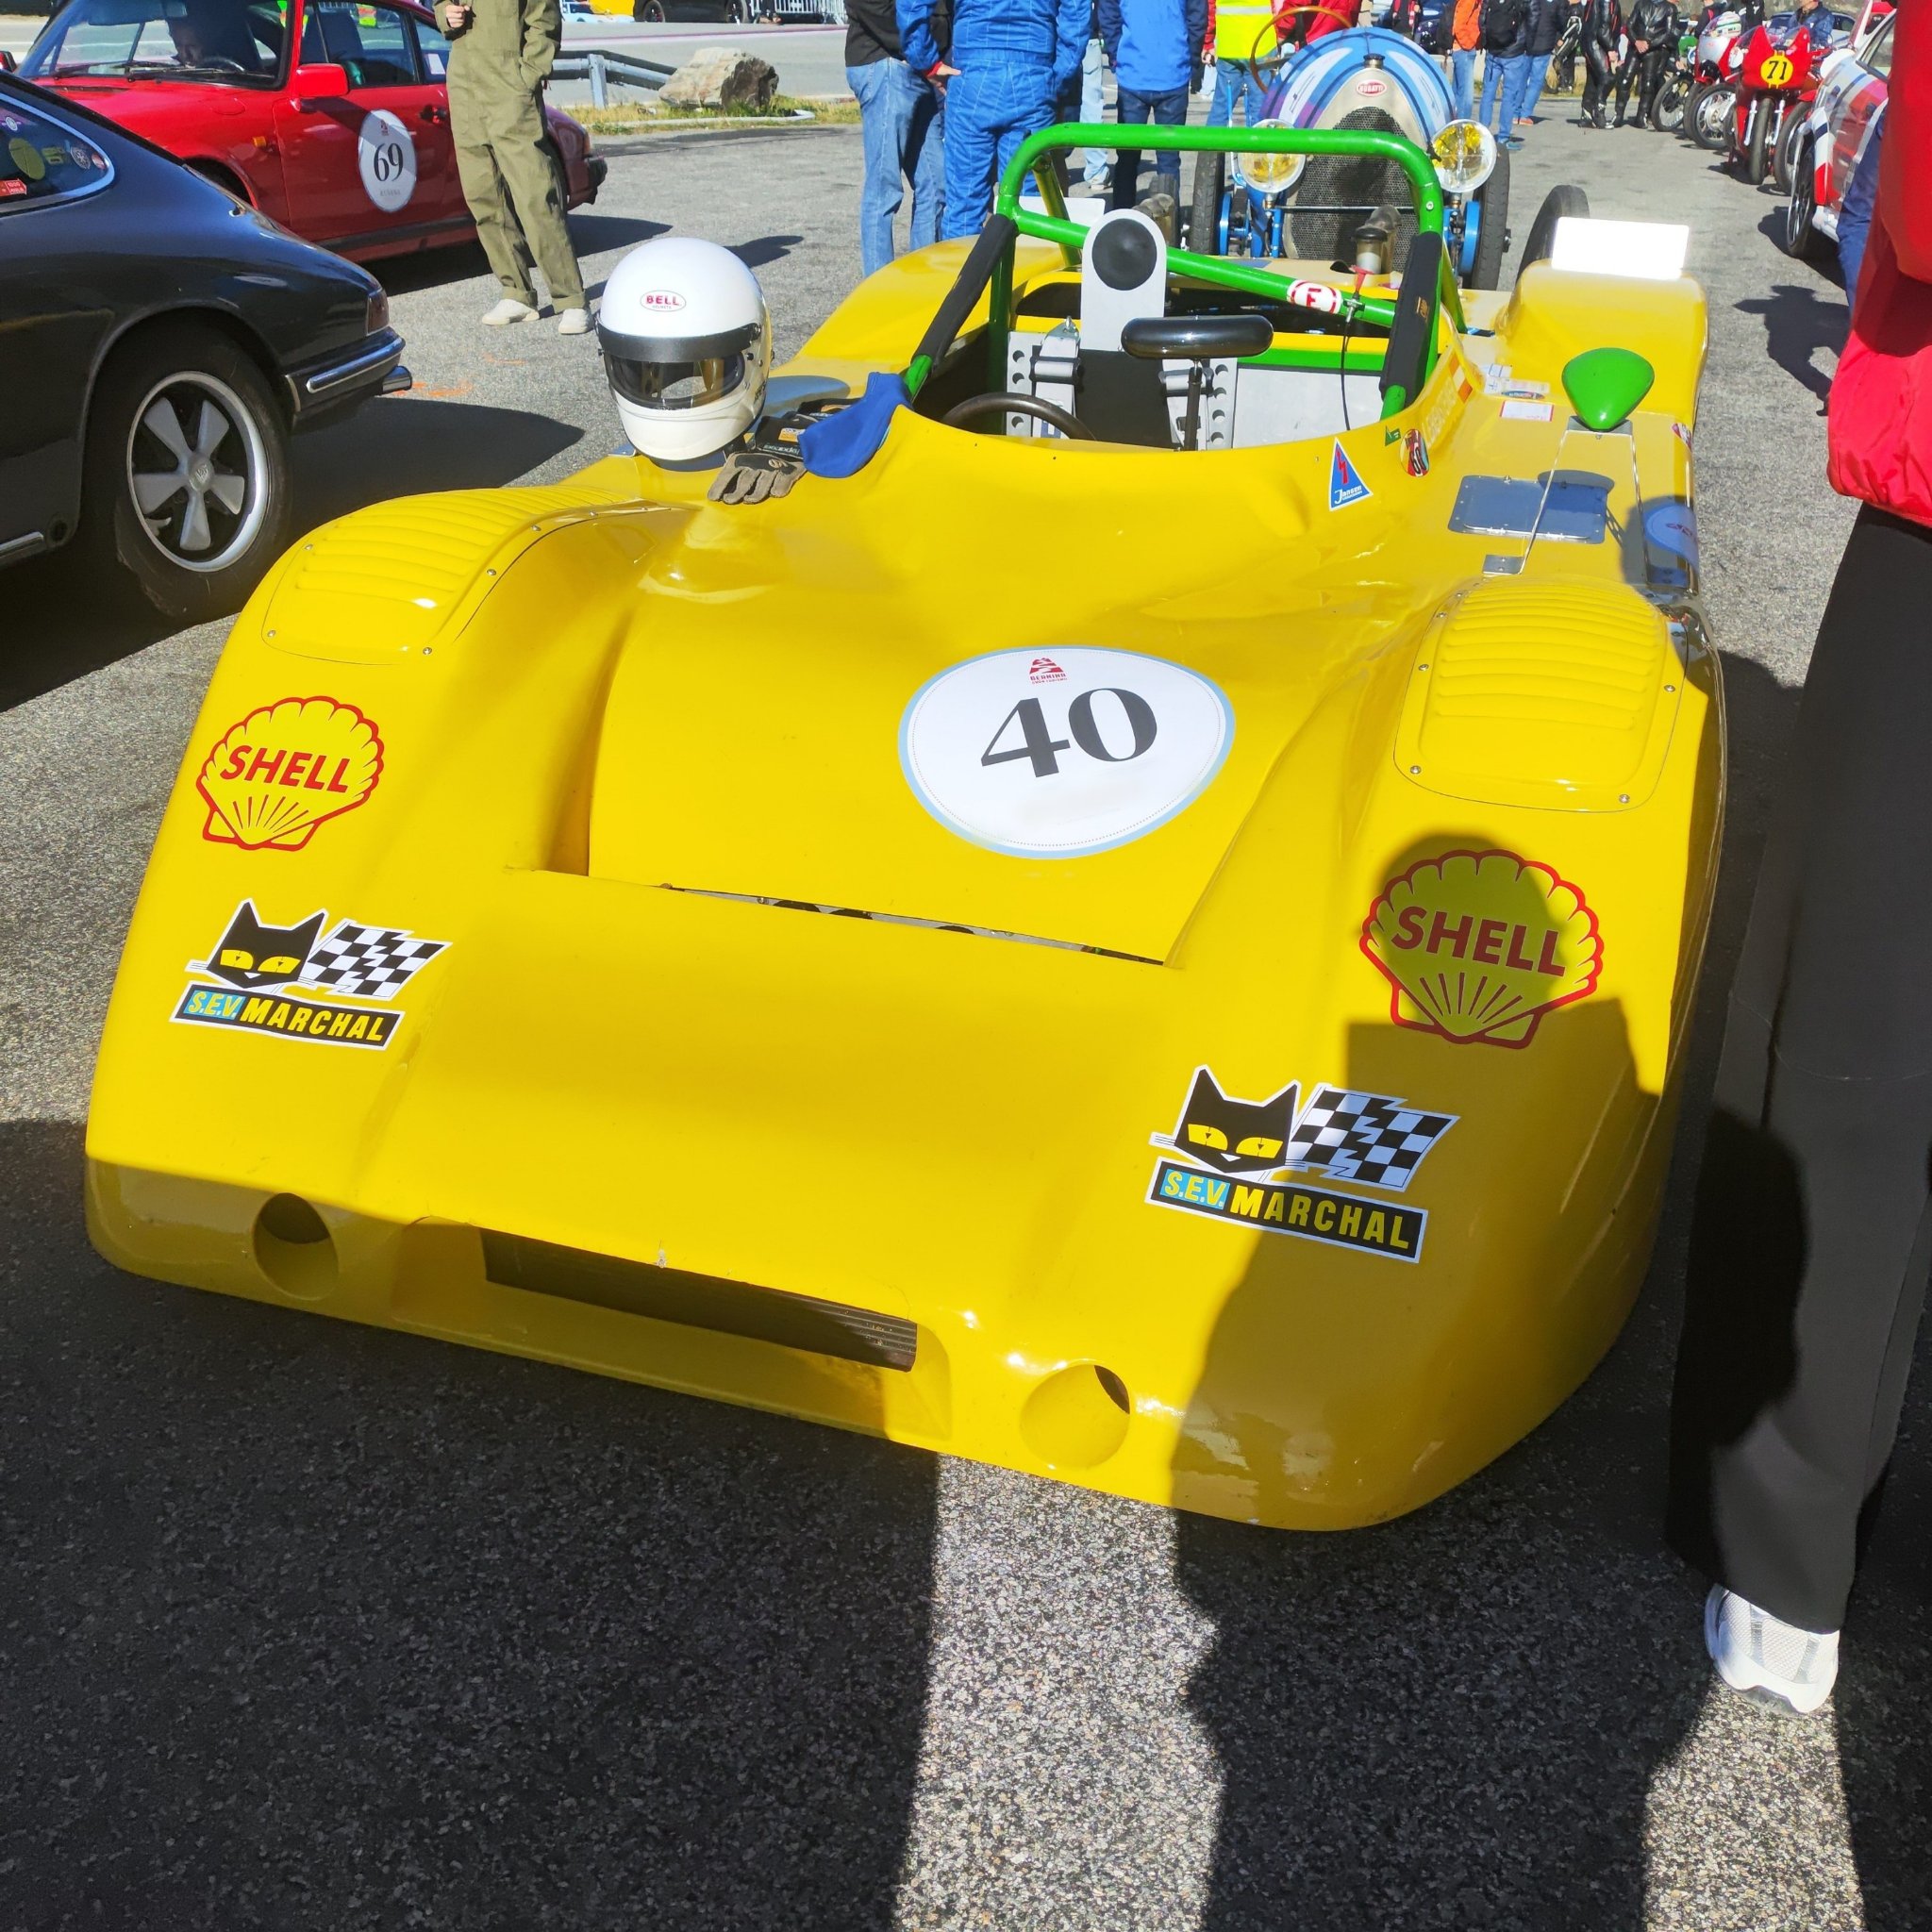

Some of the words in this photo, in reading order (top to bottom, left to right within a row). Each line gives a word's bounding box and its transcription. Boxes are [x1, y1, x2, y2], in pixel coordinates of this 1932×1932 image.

[1767, 60, 1788, 80] 71
[374, 142, 404, 181] 69
[646, 294, 680, 306] BELL
[981, 688, 1158, 778] 40
[220, 744, 350, 793] SHELL
[1391, 906, 1566, 977] SHELL
[187, 991, 242, 1019] S.E.V.
[242, 997, 383, 1041] MARCHAL
[1164, 1172, 1225, 1209] S.E.V.
[1230, 1185, 1409, 1249] MARCHAL
